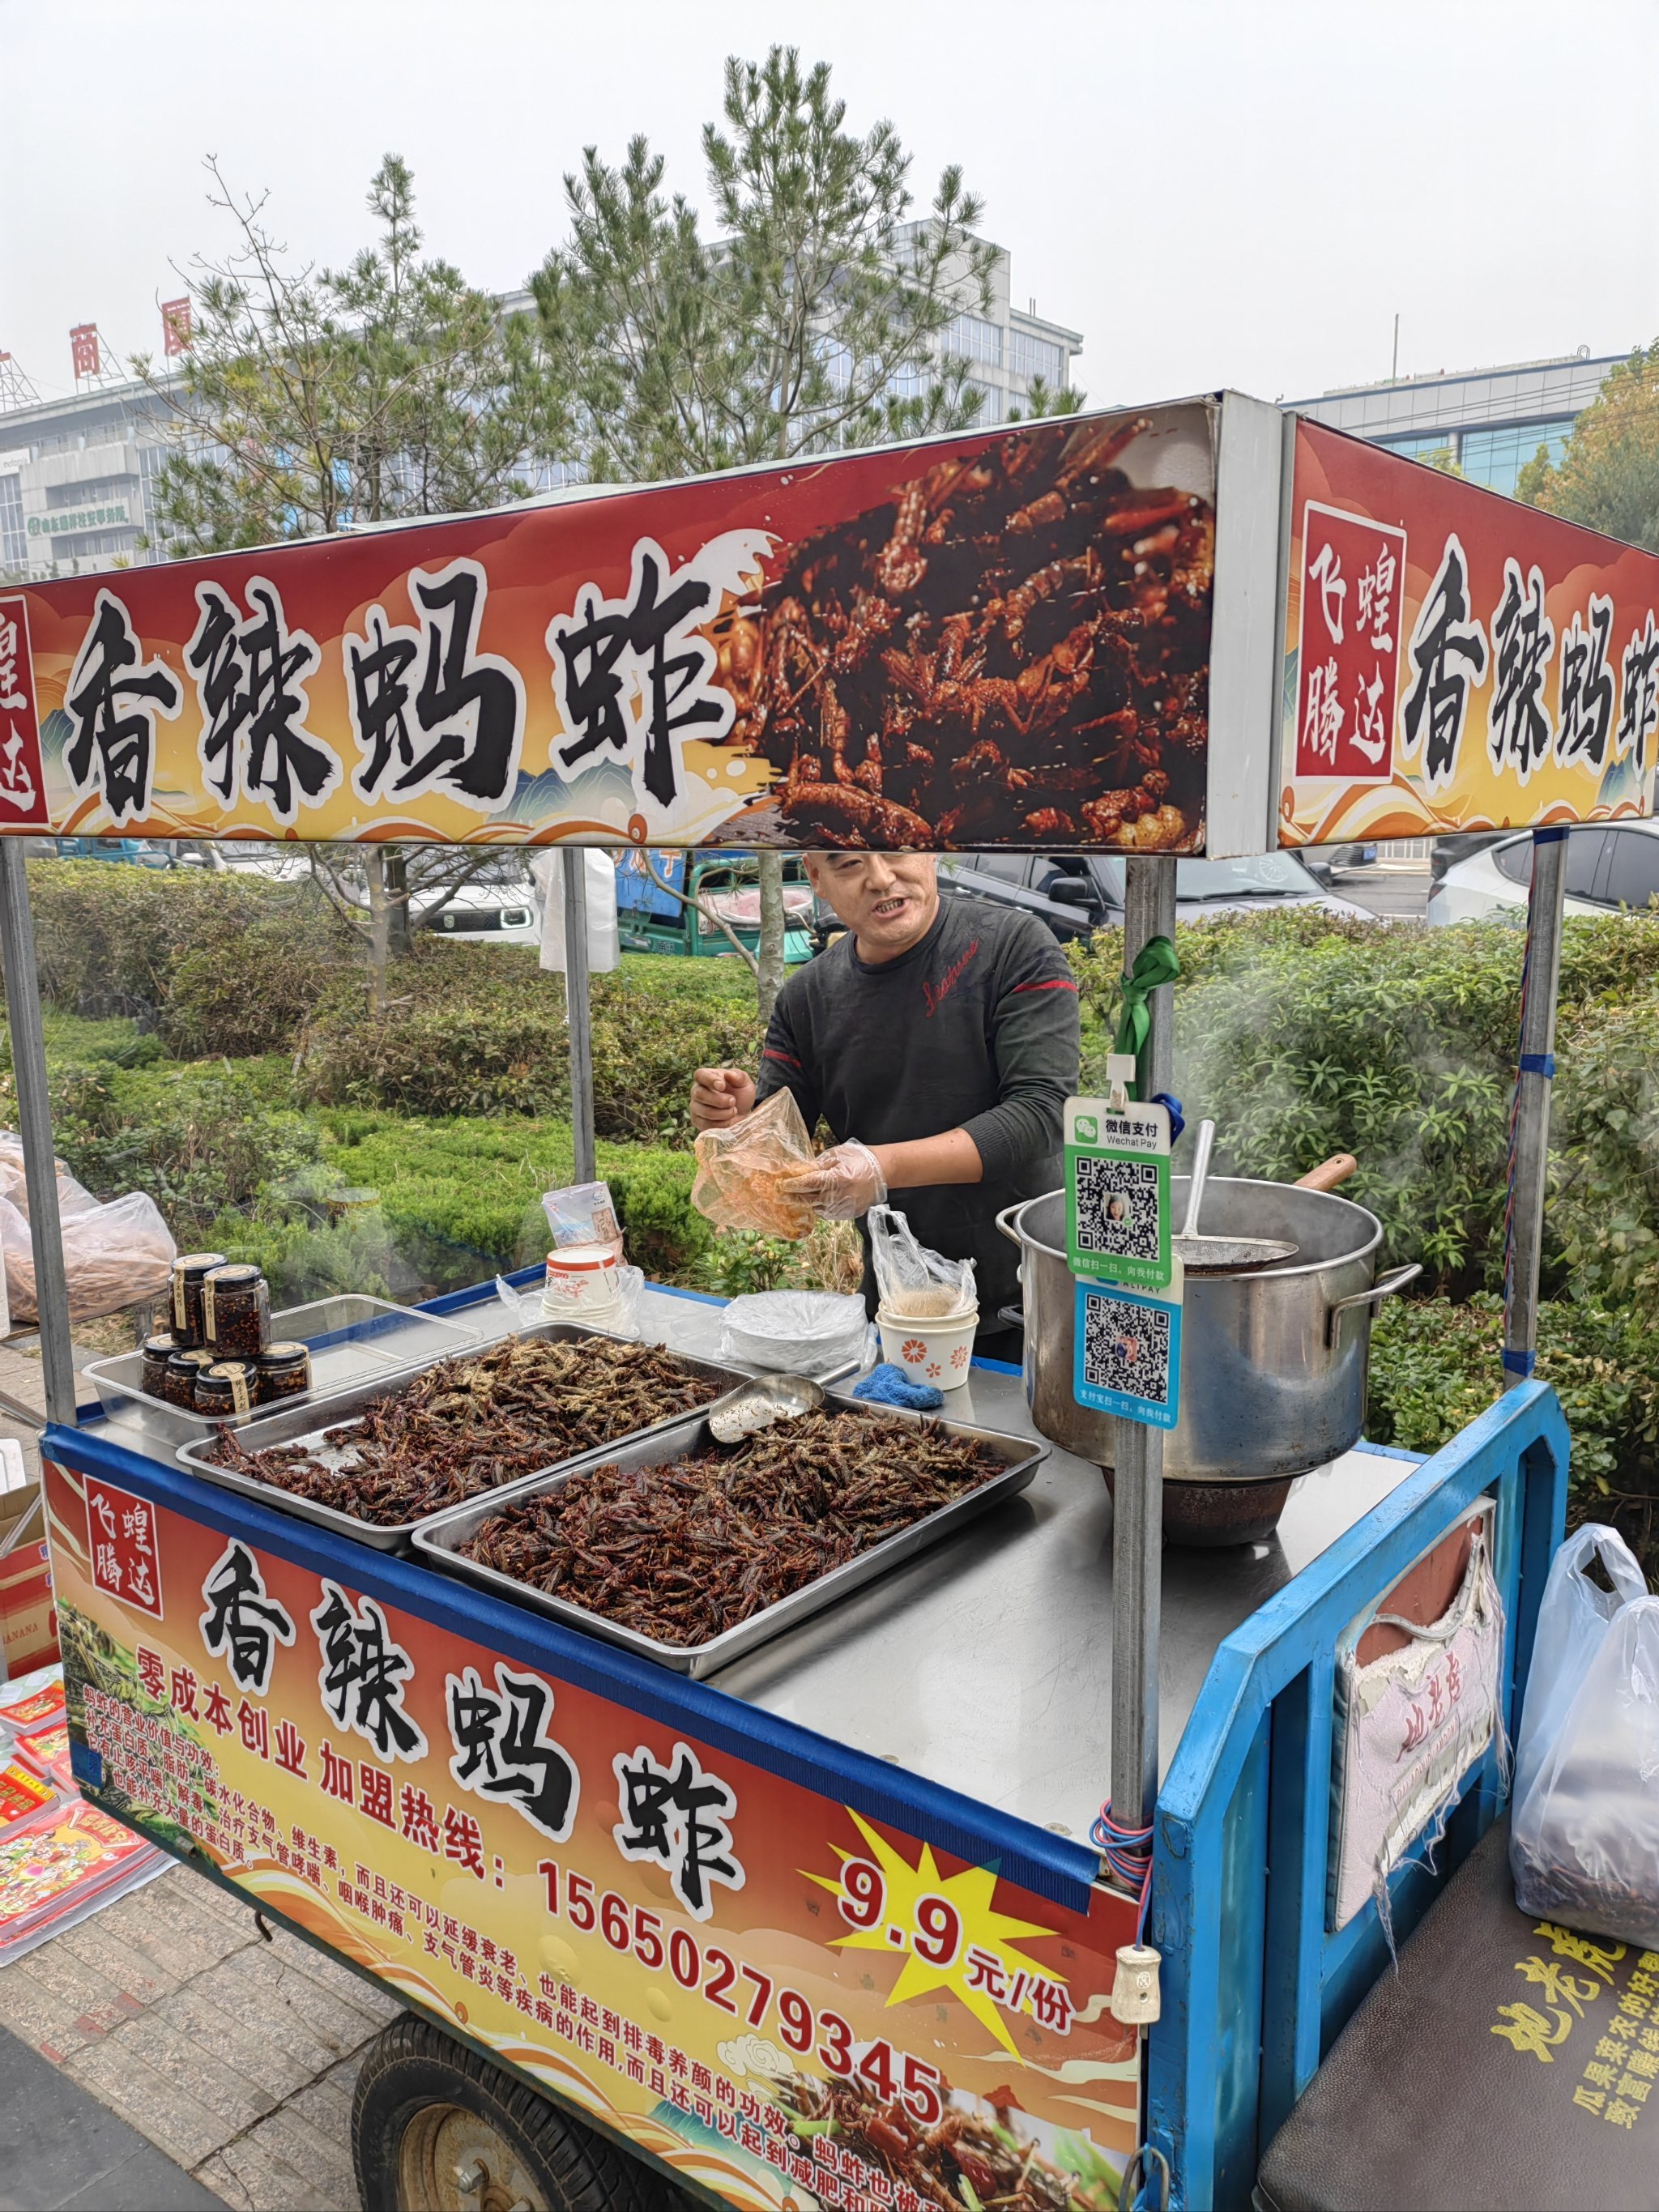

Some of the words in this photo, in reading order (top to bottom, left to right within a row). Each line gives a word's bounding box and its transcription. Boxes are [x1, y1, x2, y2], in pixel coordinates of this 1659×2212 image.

[68, 553, 725, 816] 香辣蚂蚱
[1404, 548, 1658, 780] 香辣蚂蚱
[1105, 1119, 1158, 1138] 微信支付
[1107, 1135, 1139, 1147] Wechat
[1141, 1138, 1158, 1150] Pay
[3, 1622, 39, 1645] ANANA
[204, 1543, 736, 1912] 香辣蚂蚱
[137, 1647, 308, 1780] 零成本创业
[539, 1860, 941, 2125] 15650279345
